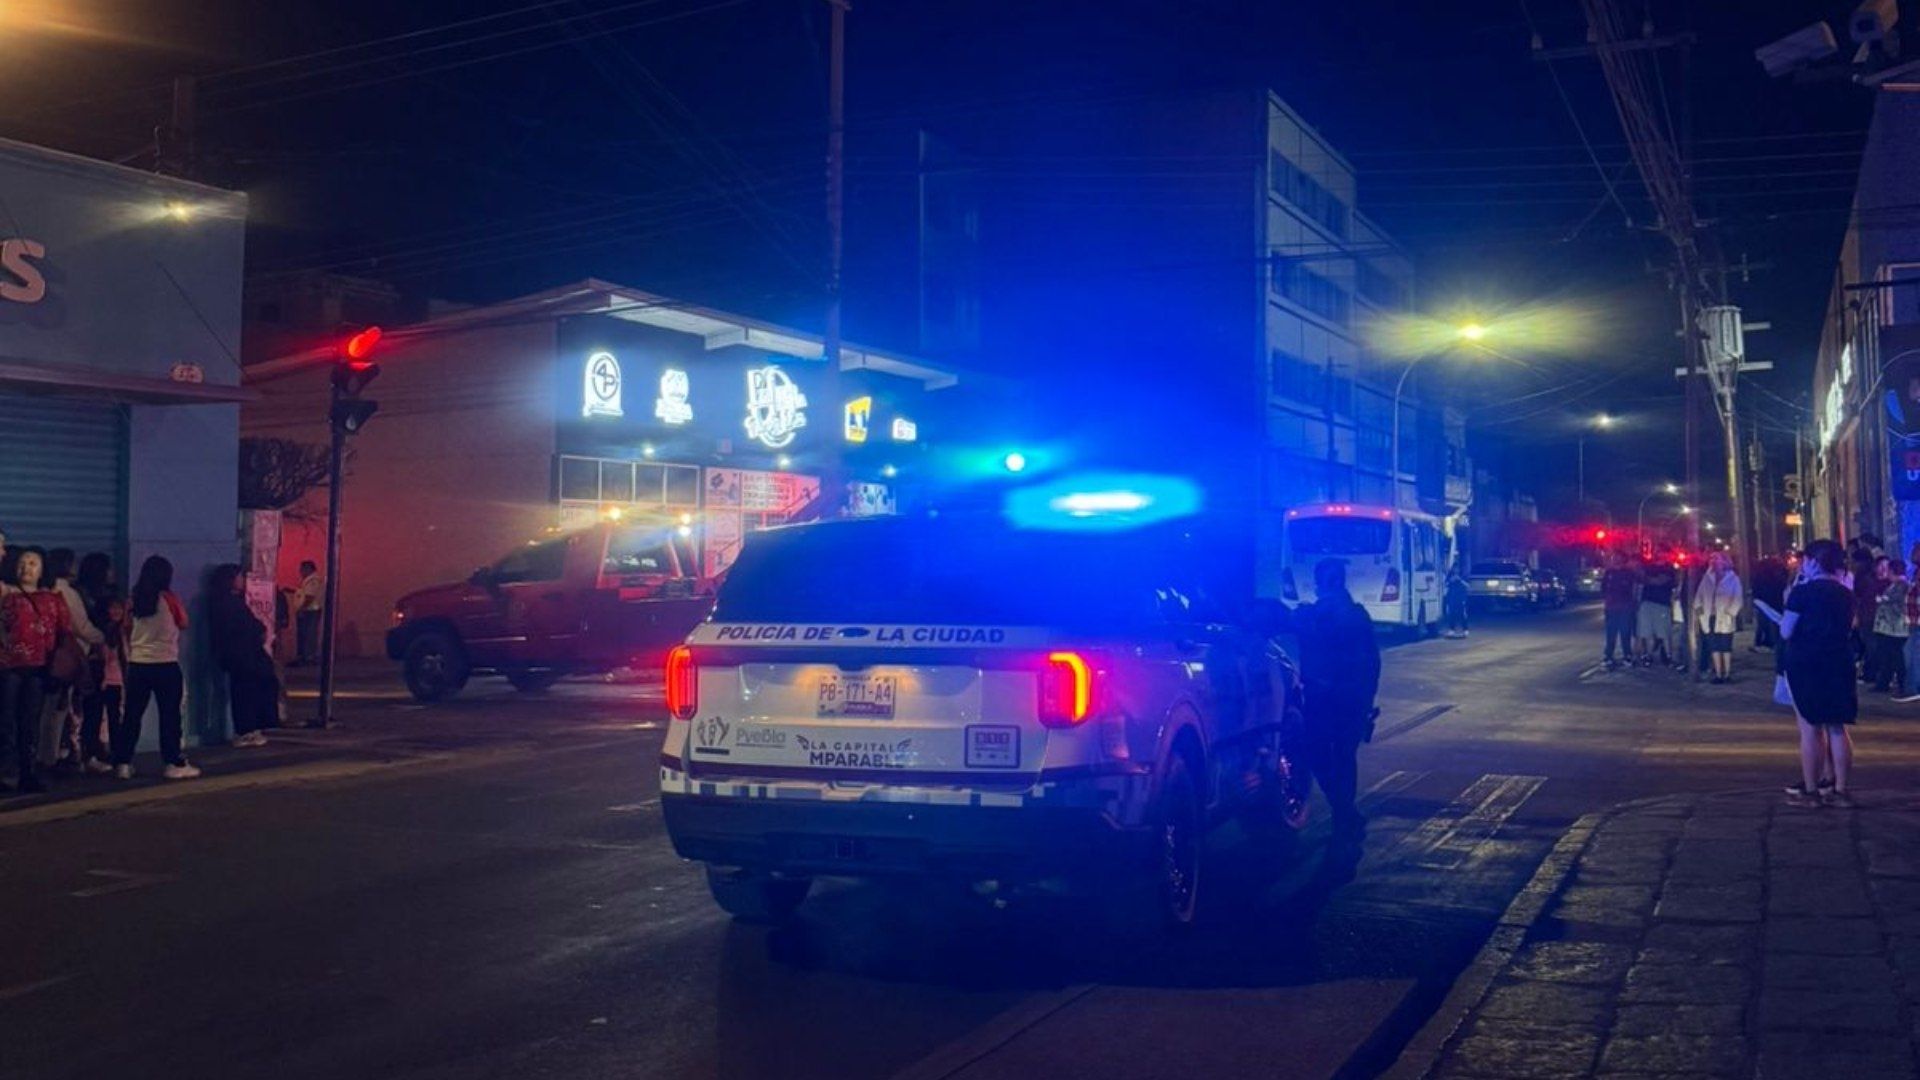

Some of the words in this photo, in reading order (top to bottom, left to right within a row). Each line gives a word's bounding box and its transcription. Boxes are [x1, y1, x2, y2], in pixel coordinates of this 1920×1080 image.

[0, 239, 45, 303] S
[803, 626, 834, 641] DE
[876, 626, 905, 642] LA
[912, 627, 1005, 643] CIUDAD
[819, 682, 891, 702] PB-171-A4
[810, 740, 827, 750] LA
[833, 742, 894, 753] CAPITAL
